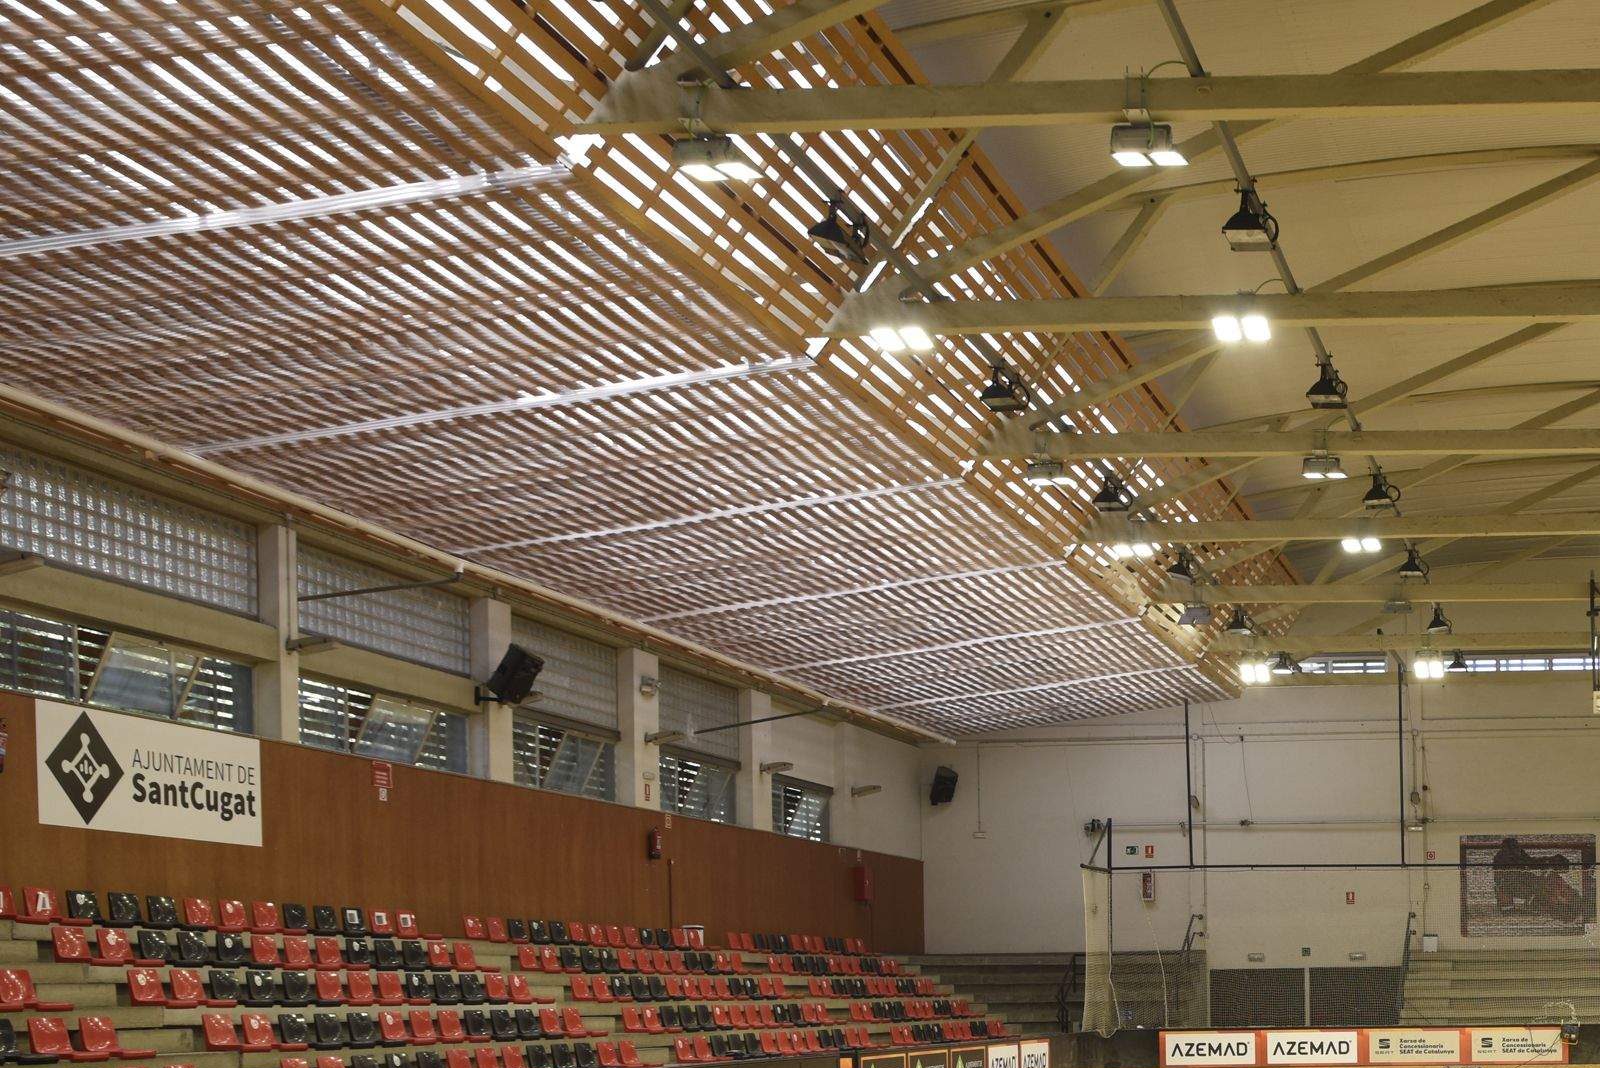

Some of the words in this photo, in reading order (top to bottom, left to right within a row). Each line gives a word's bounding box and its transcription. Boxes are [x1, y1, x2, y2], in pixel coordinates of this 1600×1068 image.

[132, 749, 233, 781] AJUNTAMENT
[237, 765, 255, 785] DE
[132, 772, 256, 821] SantCugat
[1171, 1043, 1249, 1057] AZEMAD
[1273, 1041, 1351, 1056] AZEMAD
